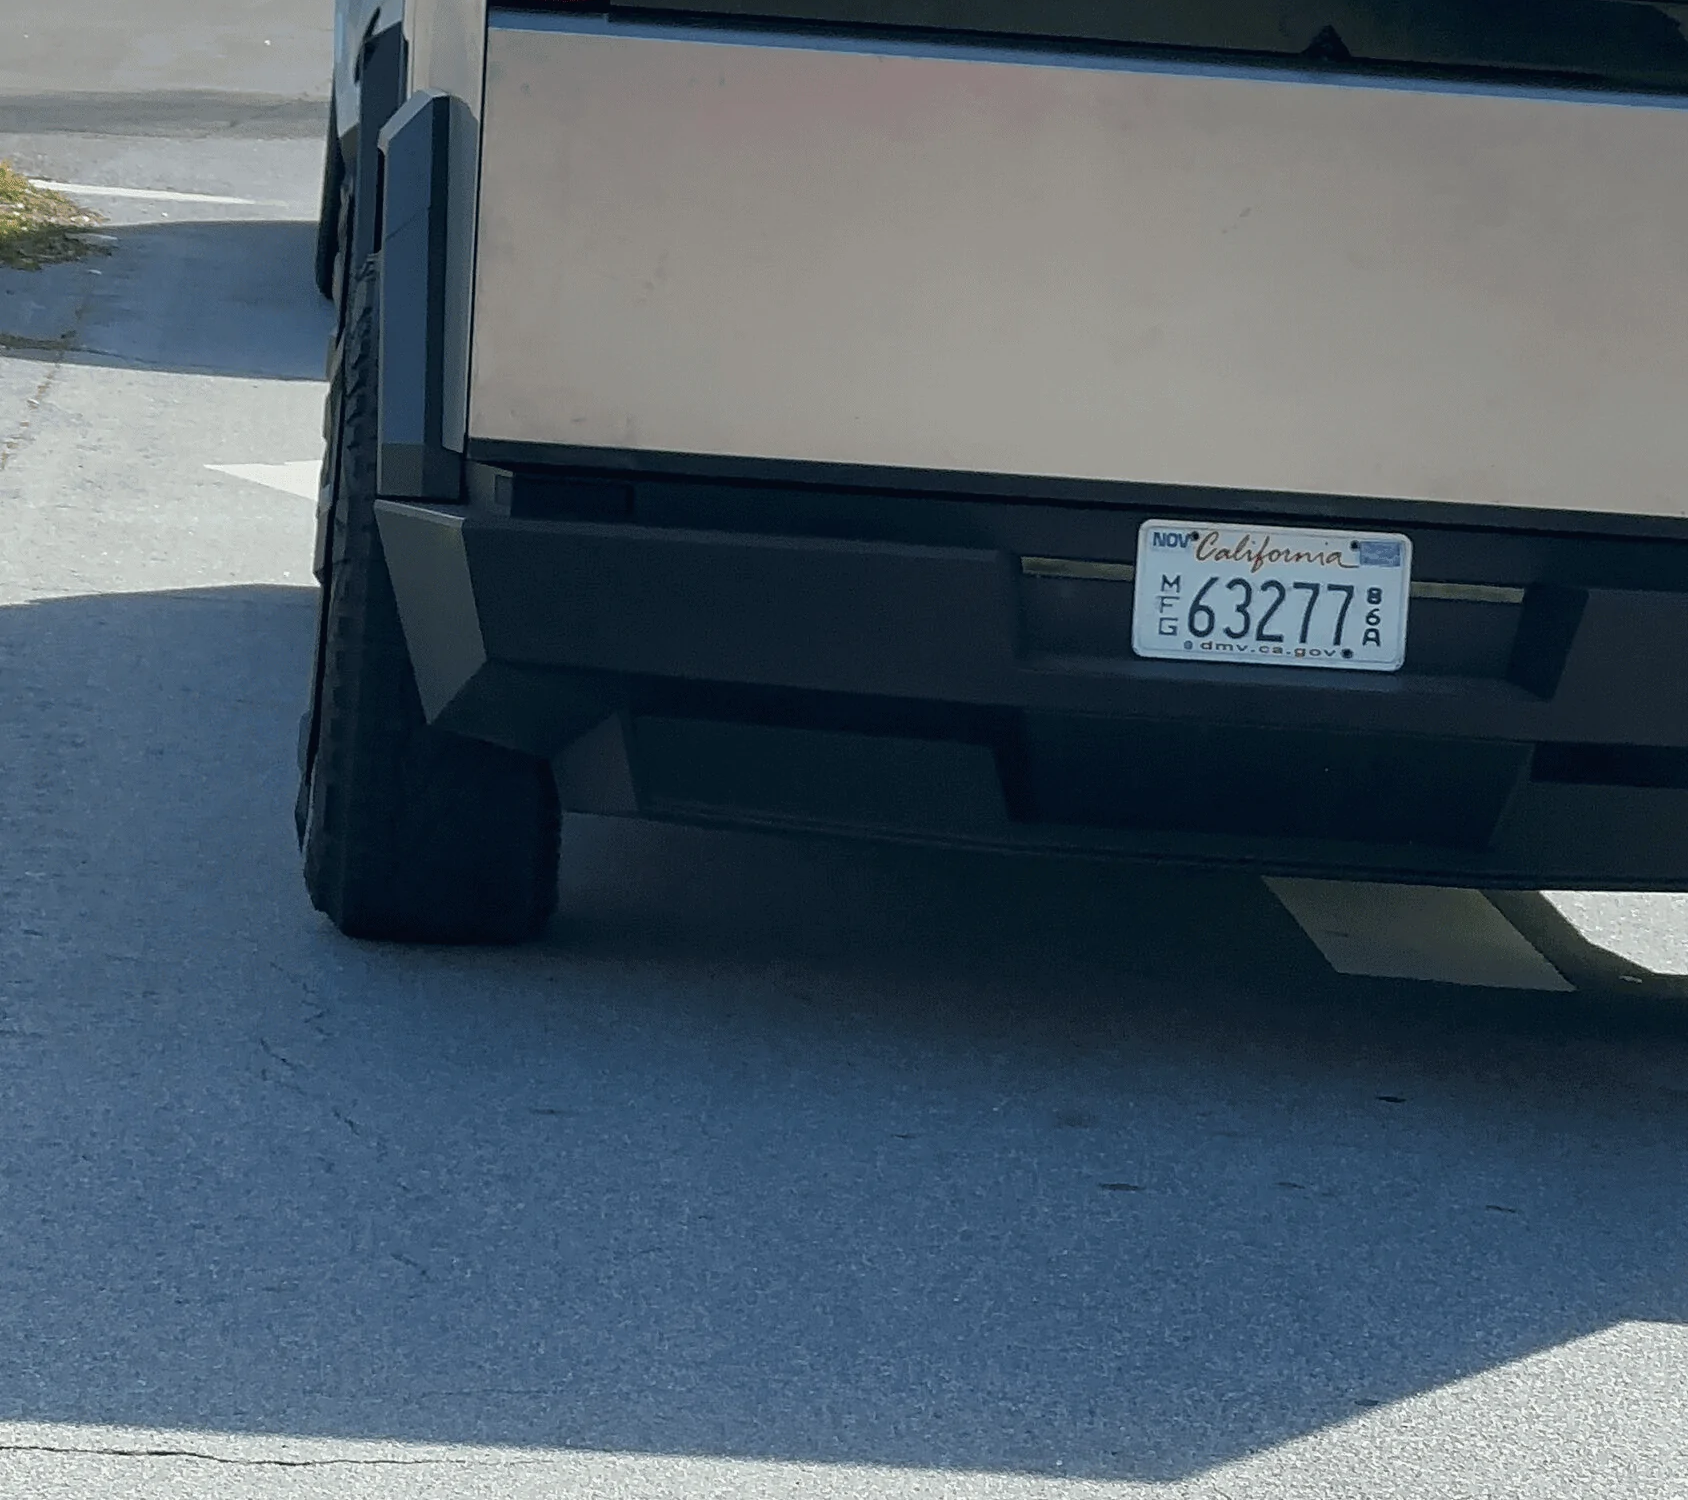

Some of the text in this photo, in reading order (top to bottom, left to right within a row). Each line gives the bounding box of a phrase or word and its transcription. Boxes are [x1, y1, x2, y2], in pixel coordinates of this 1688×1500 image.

[1153, 531, 1190, 548] NOV
[1196, 530, 1359, 573] California
[1158, 574, 1181, 636] MFG
[1187, 576, 1355, 646] 63277
[1362, 587, 1382, 647] 86A
[1200, 640, 1336, 658] dmv.ca.gov
